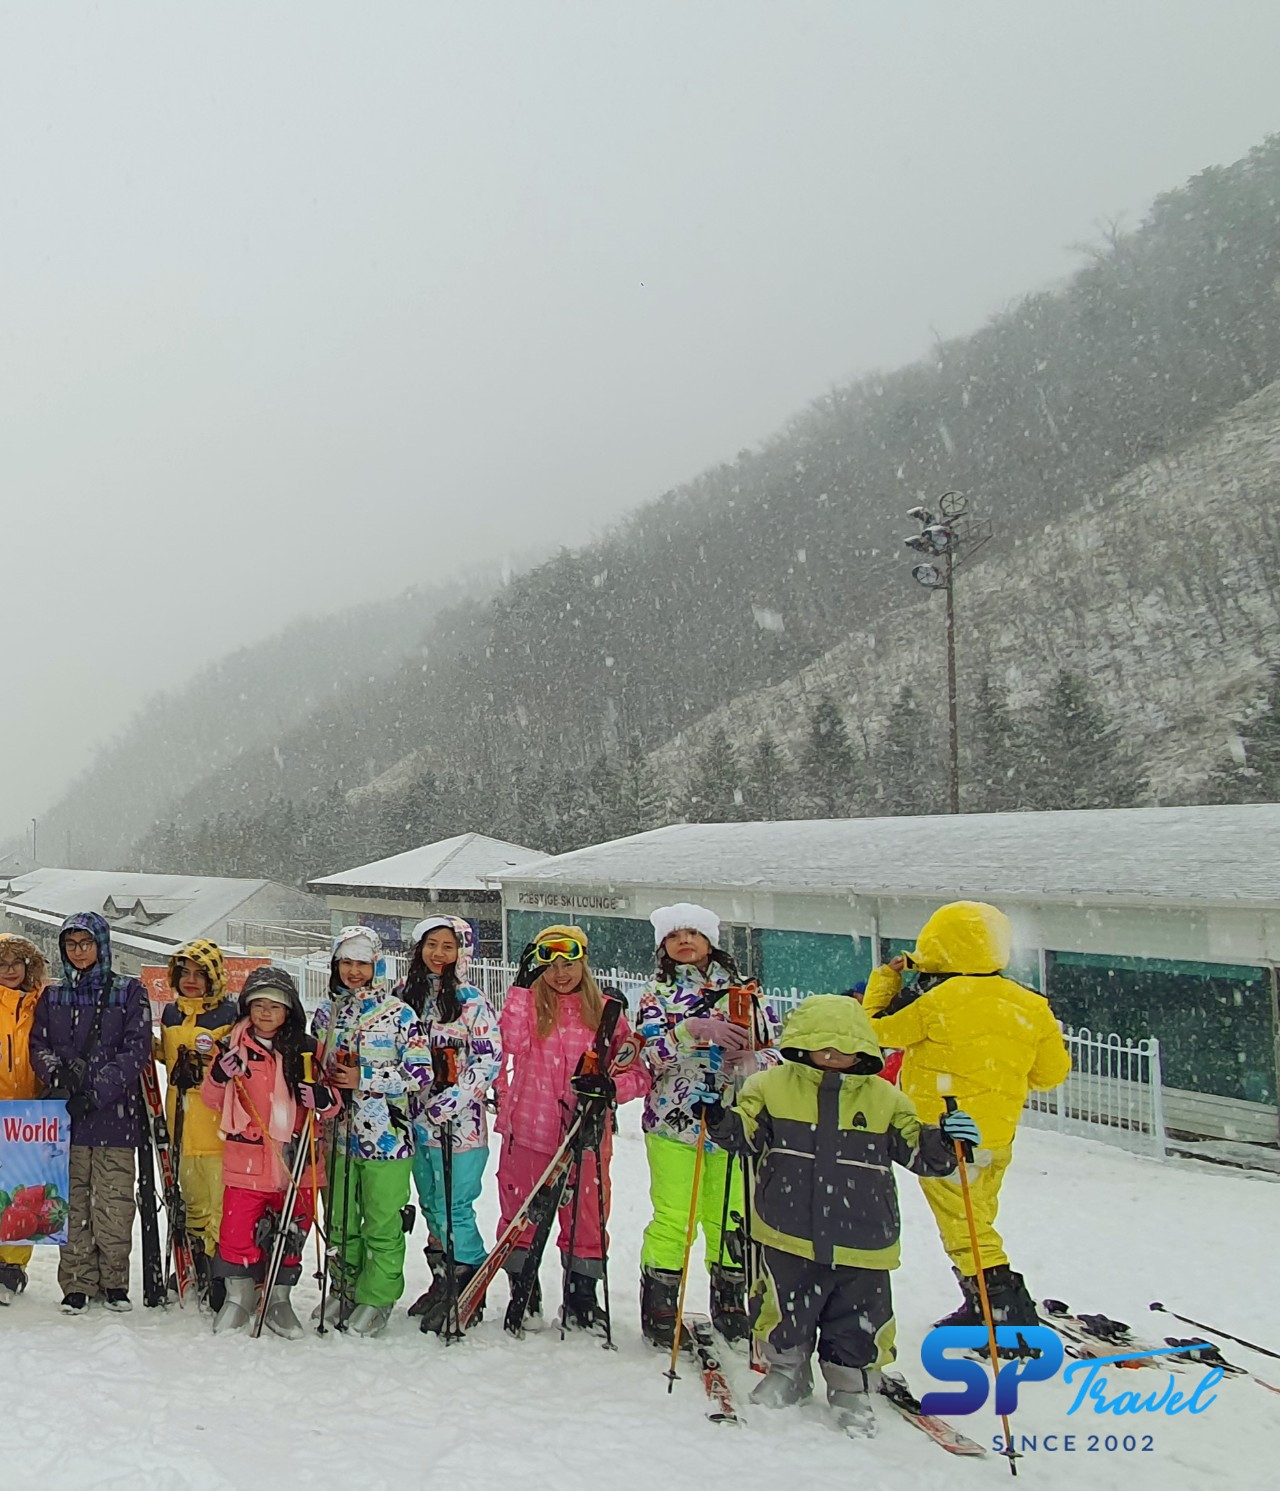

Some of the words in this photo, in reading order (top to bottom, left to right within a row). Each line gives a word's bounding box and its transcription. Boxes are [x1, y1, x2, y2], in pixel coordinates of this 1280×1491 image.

[560, 895, 575, 907] SKI
[577, 897, 617, 910] LOUNGE
[3, 1117, 59, 1143] World
